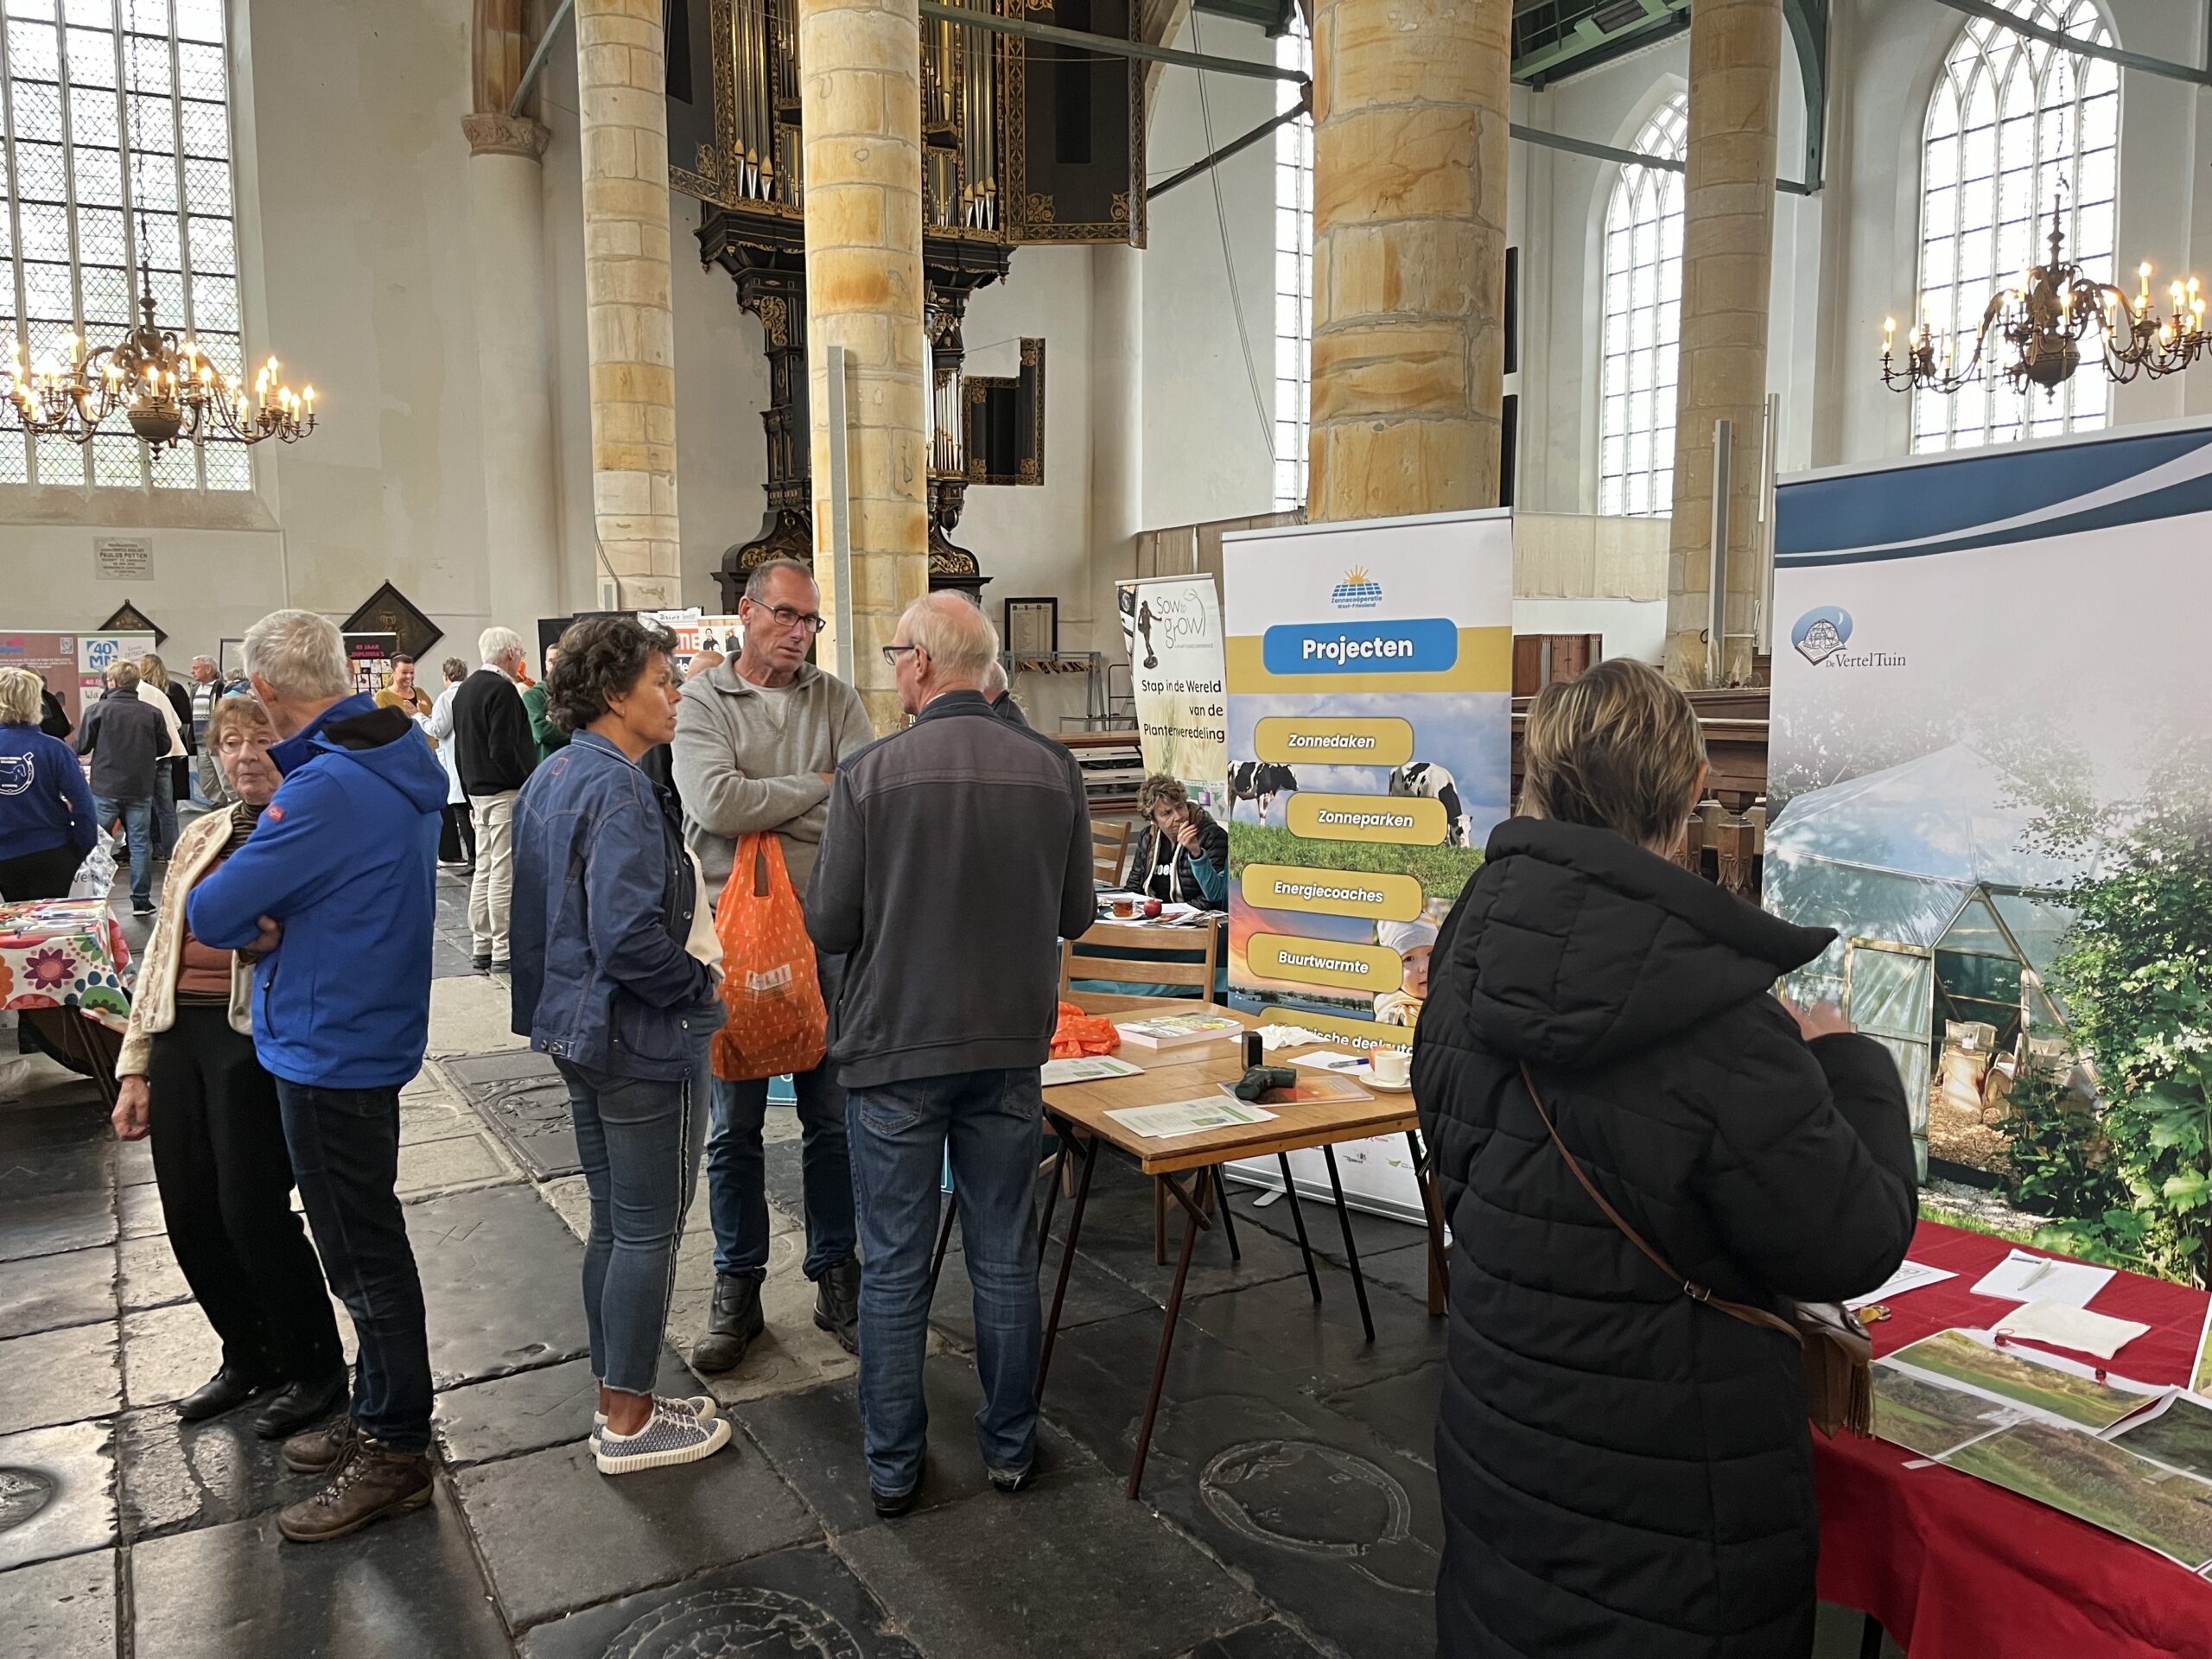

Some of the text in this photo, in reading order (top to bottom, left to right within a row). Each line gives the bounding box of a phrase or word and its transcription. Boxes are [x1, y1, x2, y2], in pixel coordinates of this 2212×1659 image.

[1156, 596, 1180, 614] Sow
[1164, 617, 1204, 649] grow
[93, 642, 112, 655] 40
[1302, 635, 1414, 665] Projecten
[1141, 679, 1222, 695] Stap in de Wereld
[1189, 703, 1224, 716] van de
[1288, 734, 1376, 748] Zonnedaken
[1318, 810, 1414, 829] Zonneparken
[1274, 881, 1383, 903] Energiecoaches
[1278, 951, 1370, 974] Buurtwarmte
